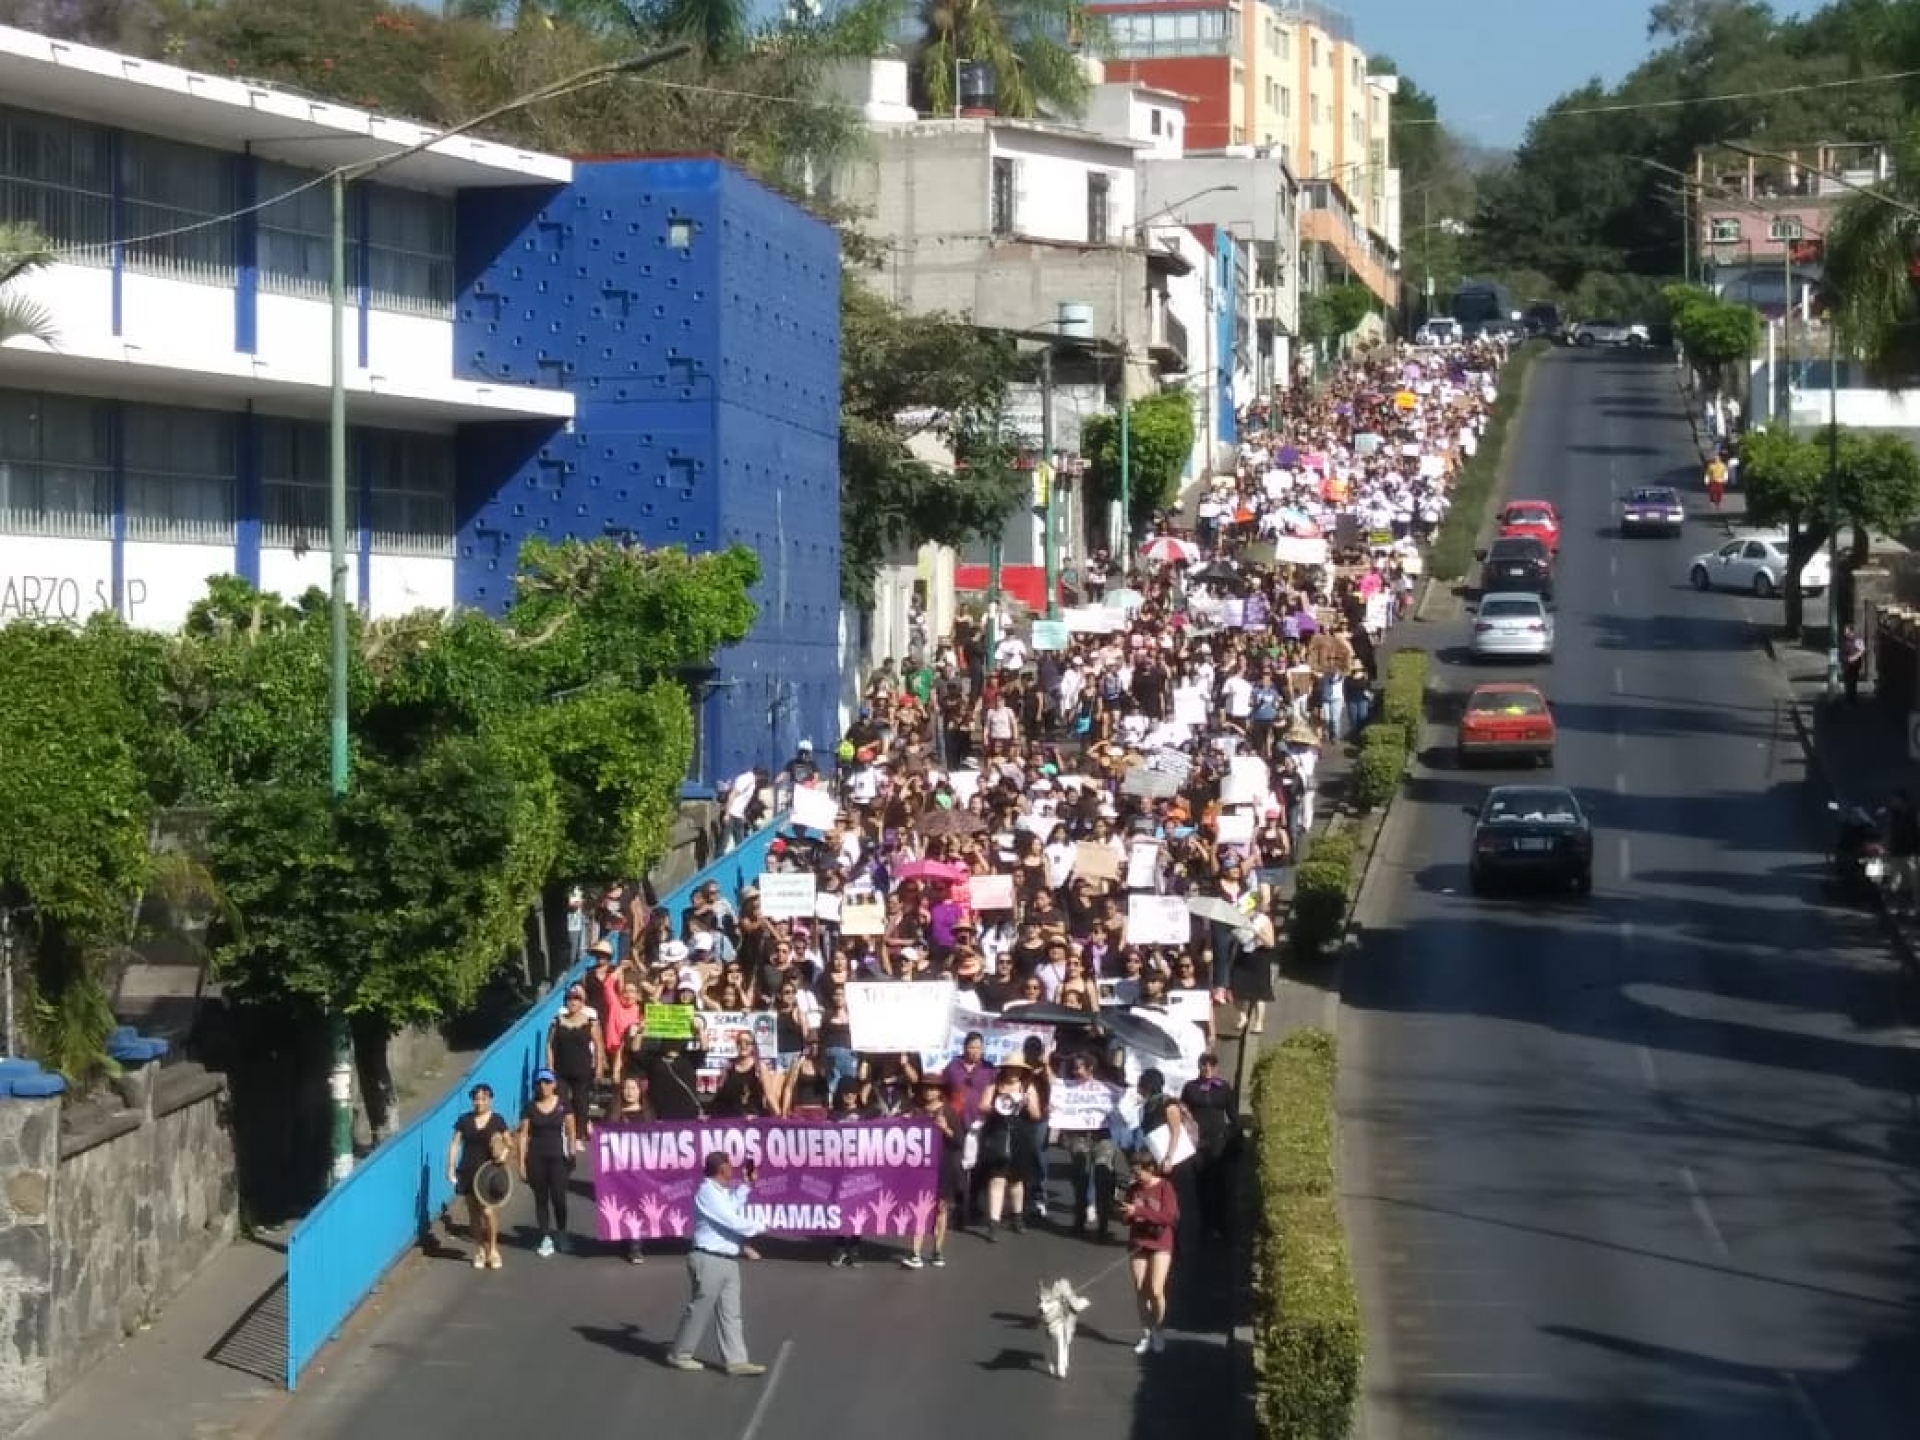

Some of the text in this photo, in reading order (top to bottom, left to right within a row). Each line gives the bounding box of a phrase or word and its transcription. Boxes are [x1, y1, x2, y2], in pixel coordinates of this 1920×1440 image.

[600, 1126, 932, 1172] ¡VIVAS NOS QUEREMOS!
